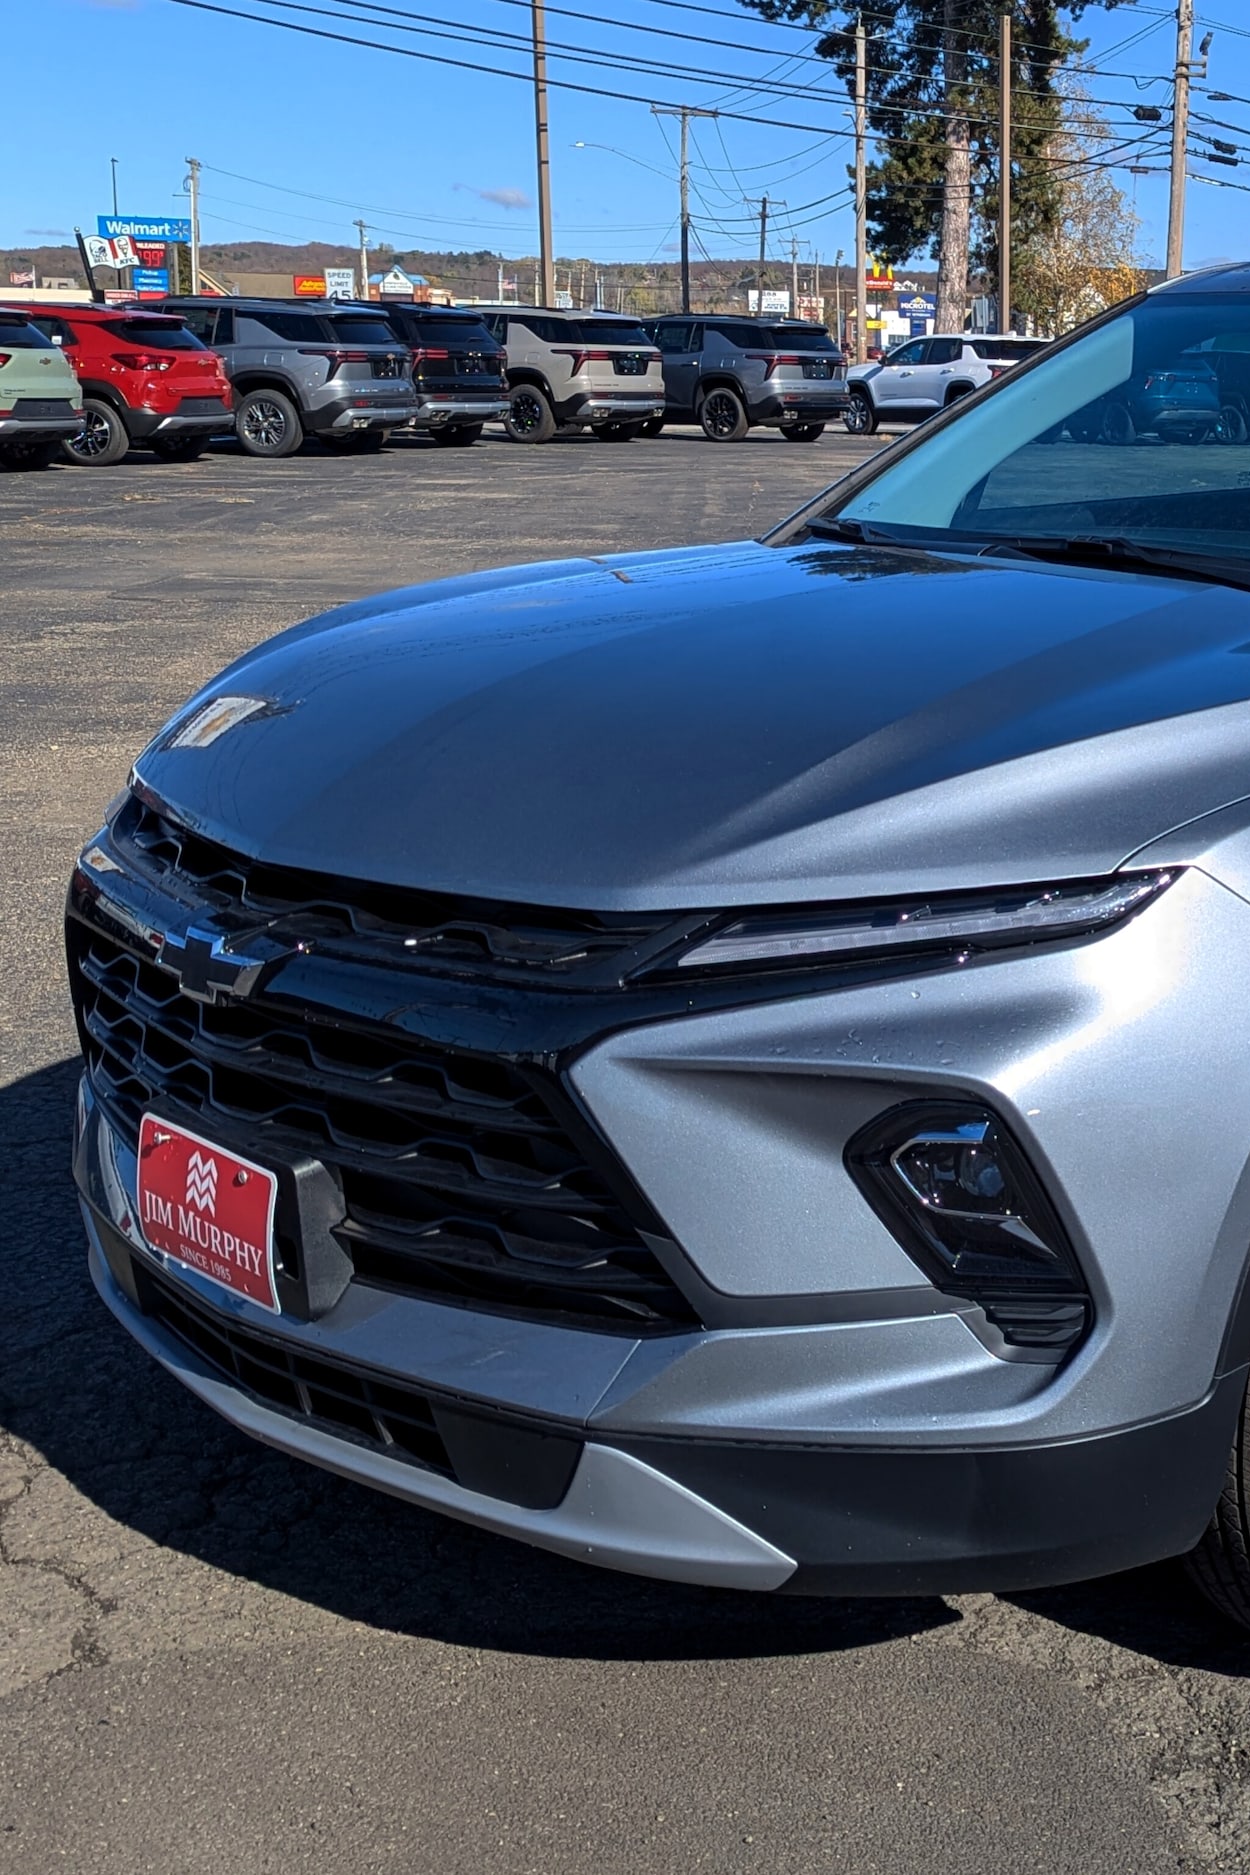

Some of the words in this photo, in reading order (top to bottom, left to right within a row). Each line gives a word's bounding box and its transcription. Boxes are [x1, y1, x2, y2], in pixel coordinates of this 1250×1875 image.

[106, 221, 171, 236] Walmart
[120, 257, 136, 265] KFC
[329, 290, 352, 300] 45
[144, 1190, 174, 1230] JIM
[178, 1204, 263, 1277] MURPHY
[179, 1244, 209, 1269] SINCE
[211, 1260, 232, 1282] 1985
